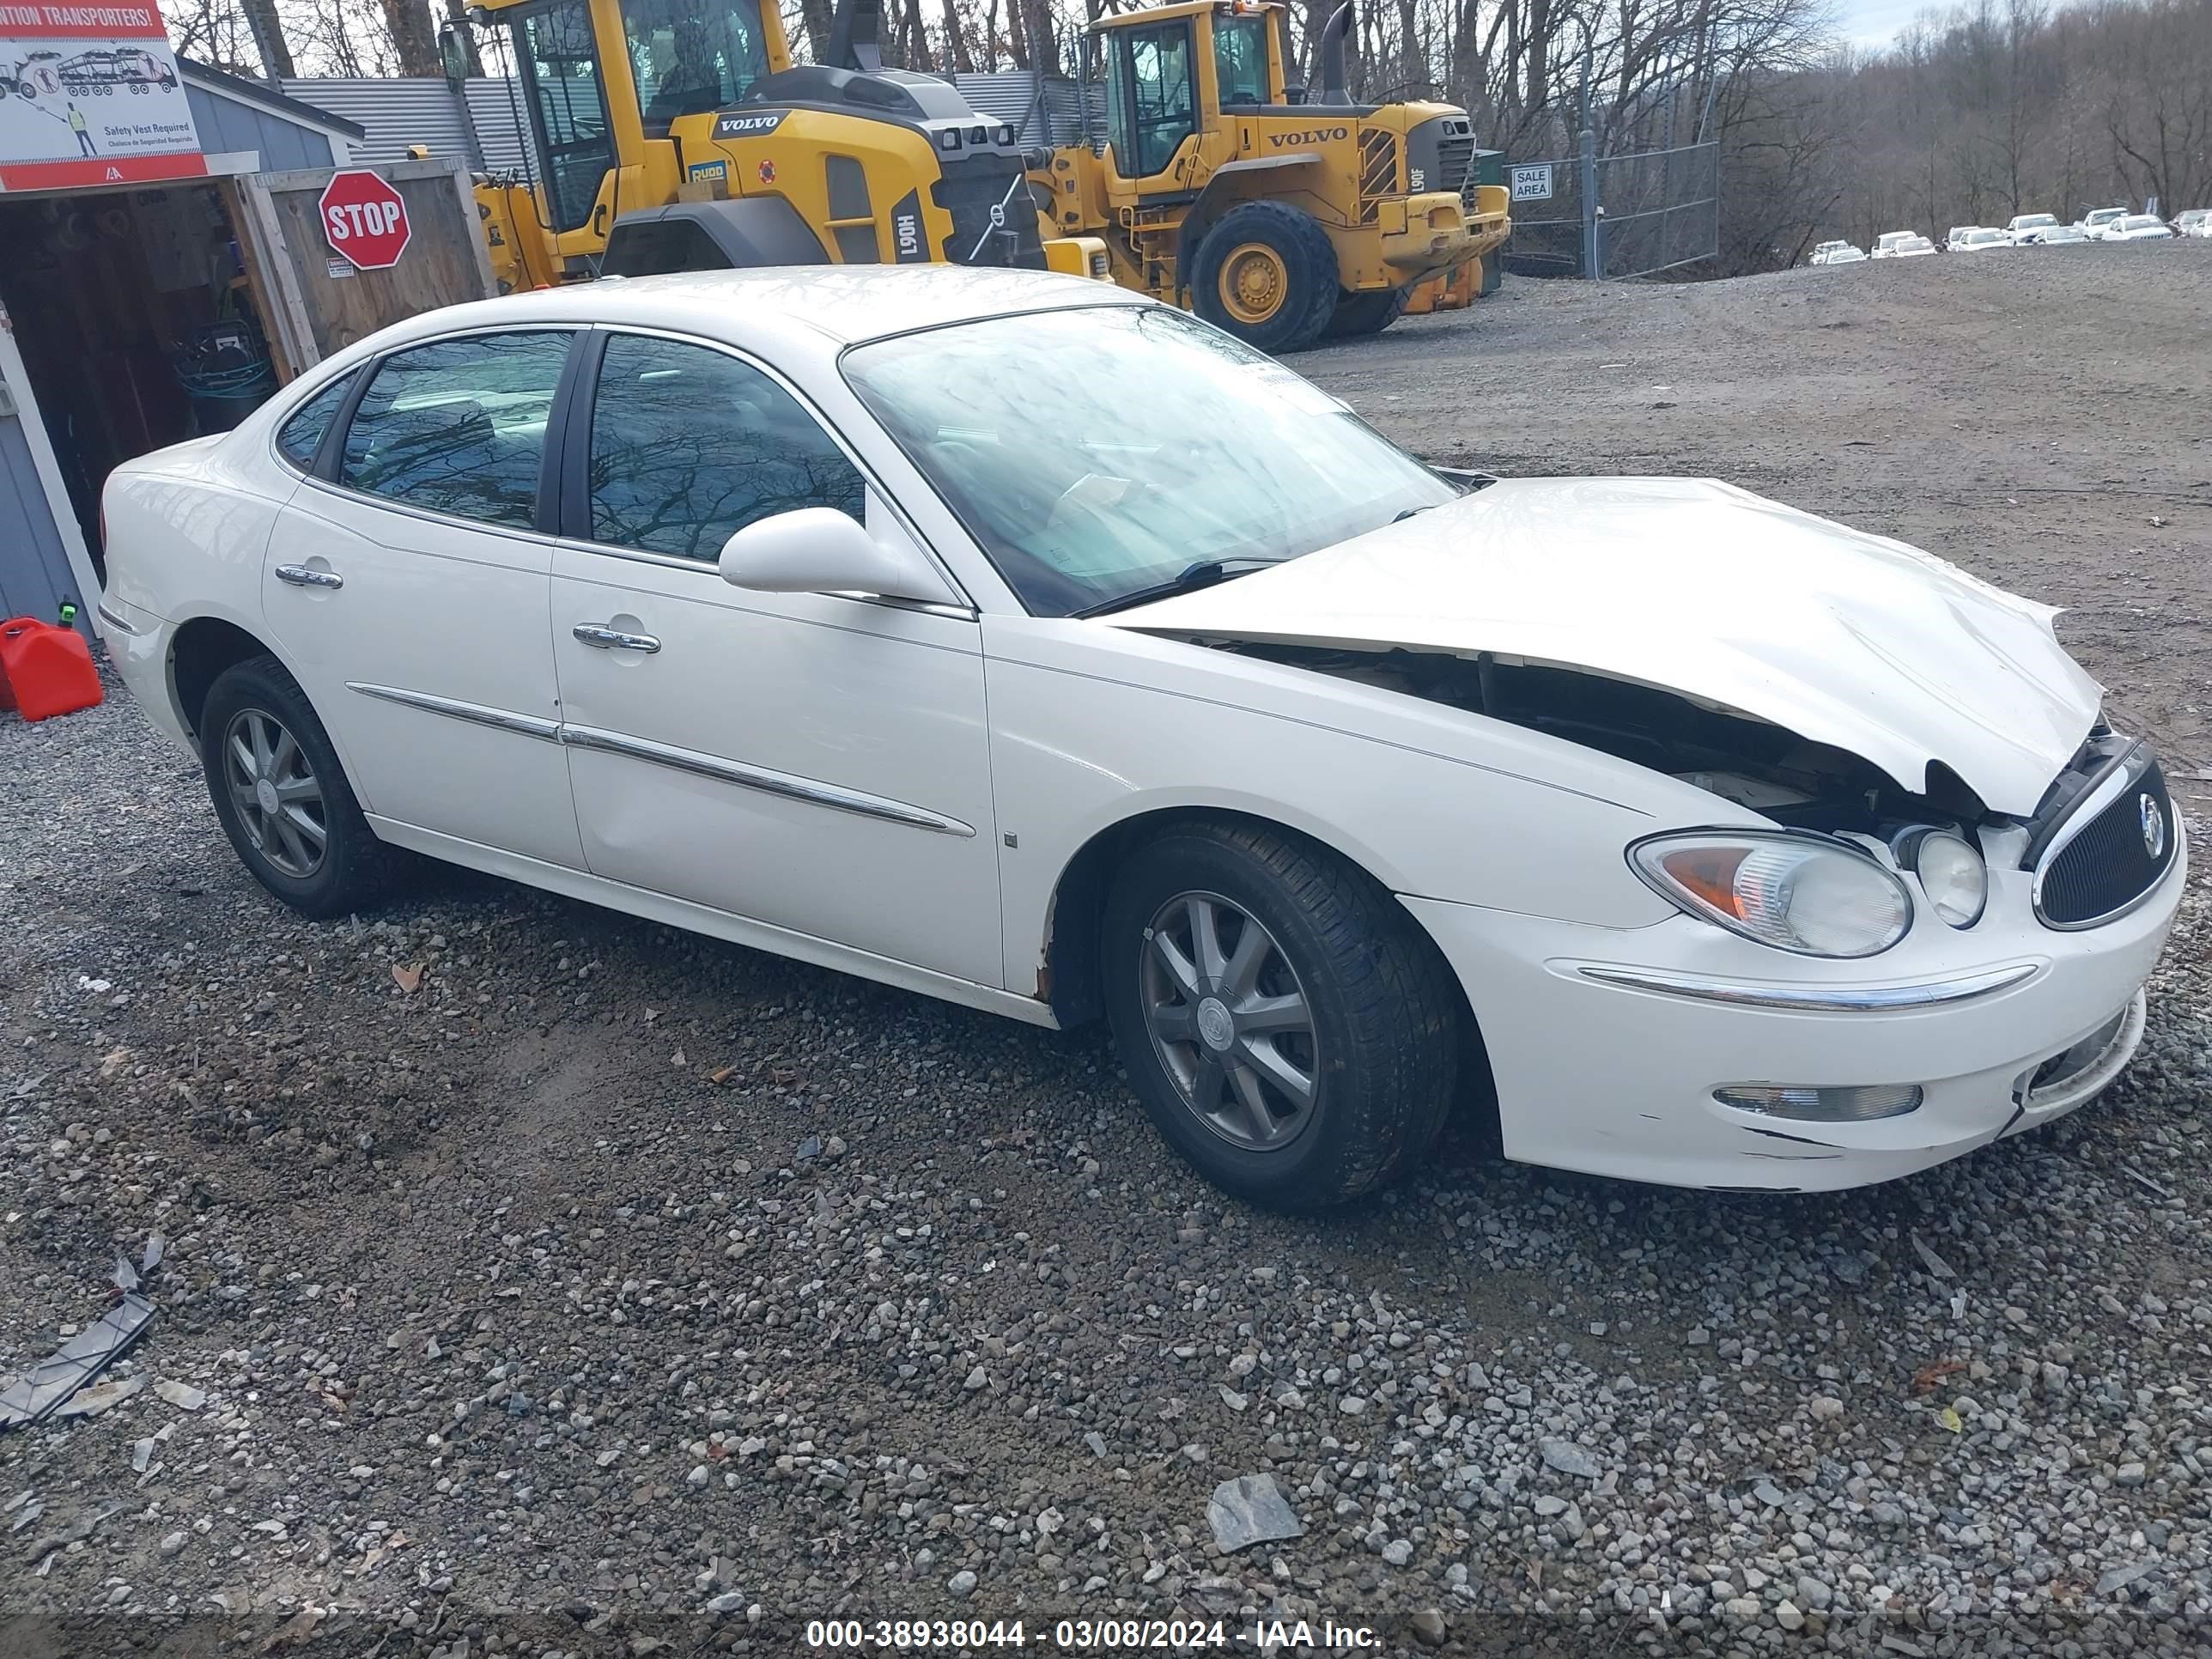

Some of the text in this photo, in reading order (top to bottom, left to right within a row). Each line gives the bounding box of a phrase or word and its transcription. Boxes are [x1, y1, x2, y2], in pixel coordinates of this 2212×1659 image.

[42, 7, 154, 27] TRANSPORTERS!
[104, 122, 190, 137] Safety Vest Required
[720, 116, 778, 131] VOLVO
[1267, 127, 1348, 148] VOLVO
[691, 166, 724, 184] RUDD
[1411, 168, 1425, 192] L90F
[1517, 170, 1546, 183] SALE
[1516, 184, 1547, 197] AREA
[328, 201, 400, 240] STOP
[897, 215, 918, 255] L90H
